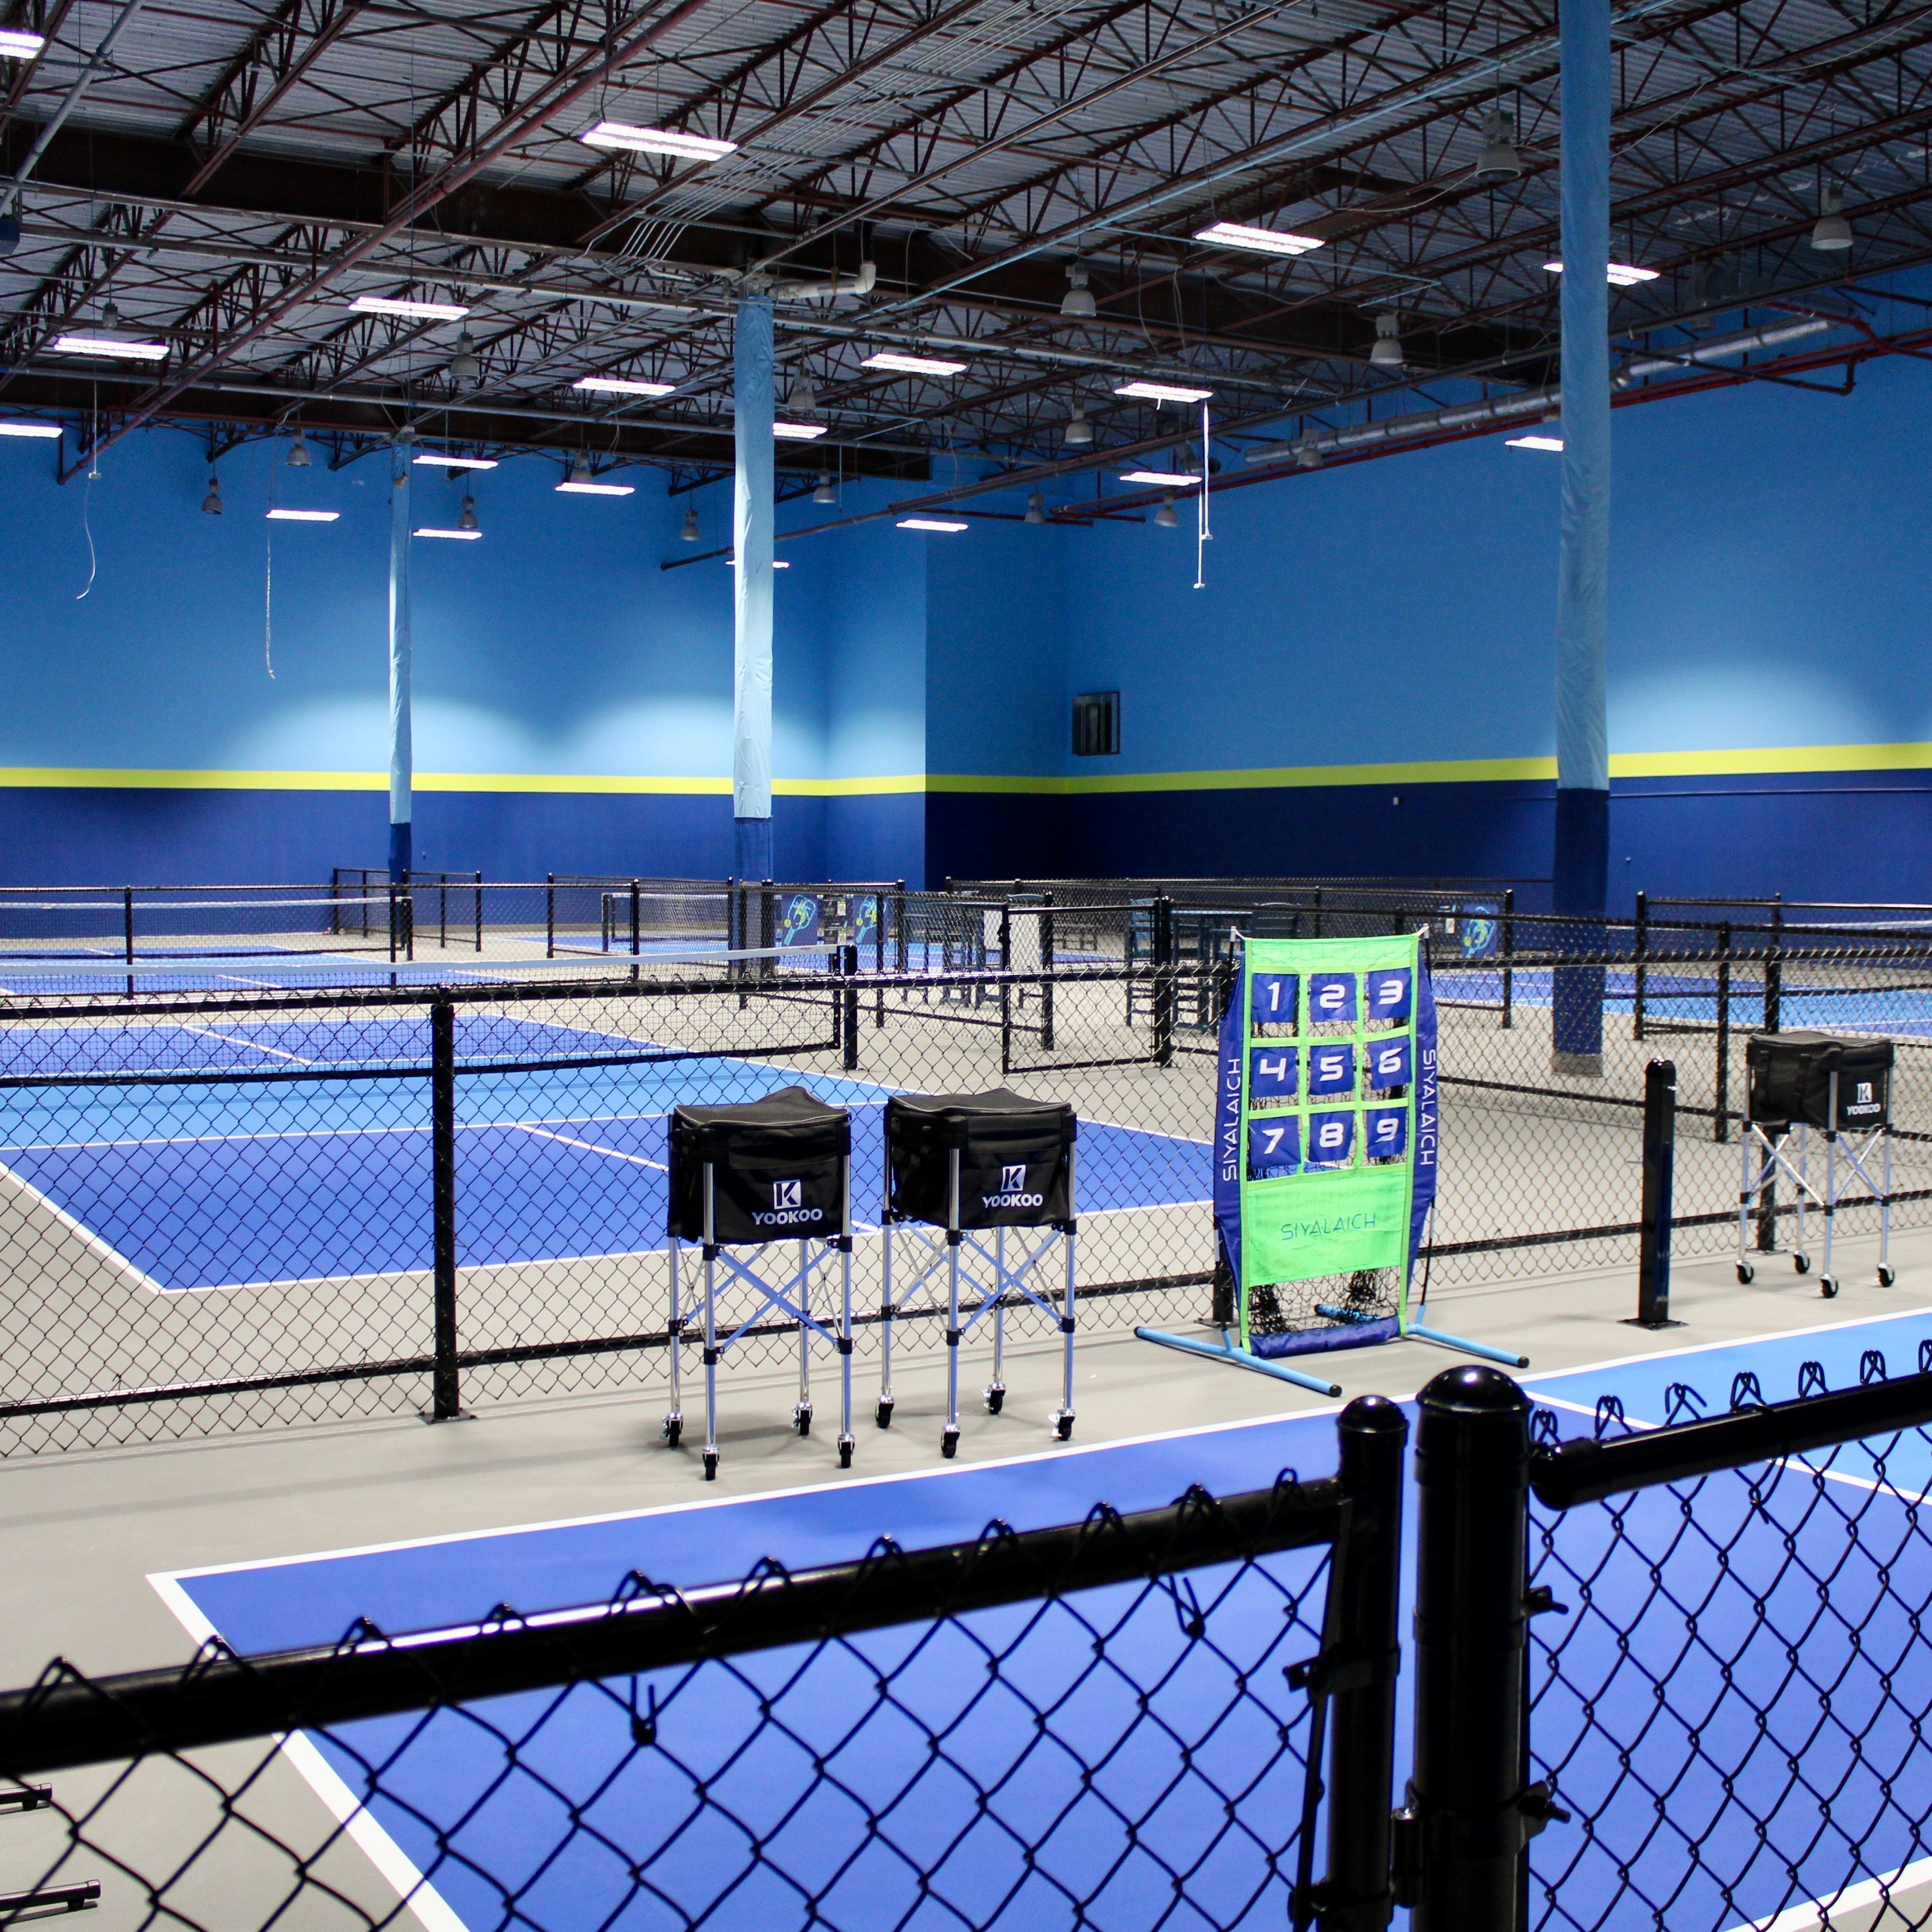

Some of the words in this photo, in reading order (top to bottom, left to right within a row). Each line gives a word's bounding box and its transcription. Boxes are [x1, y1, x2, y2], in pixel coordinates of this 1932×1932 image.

[1268, 982, 1280, 1011] 1
[1319, 984, 1345, 1008] 2
[1378, 979, 1403, 1005] 3
[1259, 1058, 1287, 1082] 4
[1319, 1056, 1344, 1081] 5
[1378, 1048, 1402, 1074] 6
[1223, 1058, 1241, 1181] SIYALAICH
[1420, 1048, 1436, 1166] SIYALAICH
[1262, 1127, 1284, 1154] 7
[1319, 1122, 1344, 1148] 8
[1376, 1118, 1399, 1142] 9
[1002, 1166, 1024, 1191] K
[775, 1180, 799, 1208] K
[982, 1194, 1043, 1208] YOOKOO
[752, 1209, 823, 1225] YOOKOO
[1281, 1213, 1376, 1240] SIYALAICH
